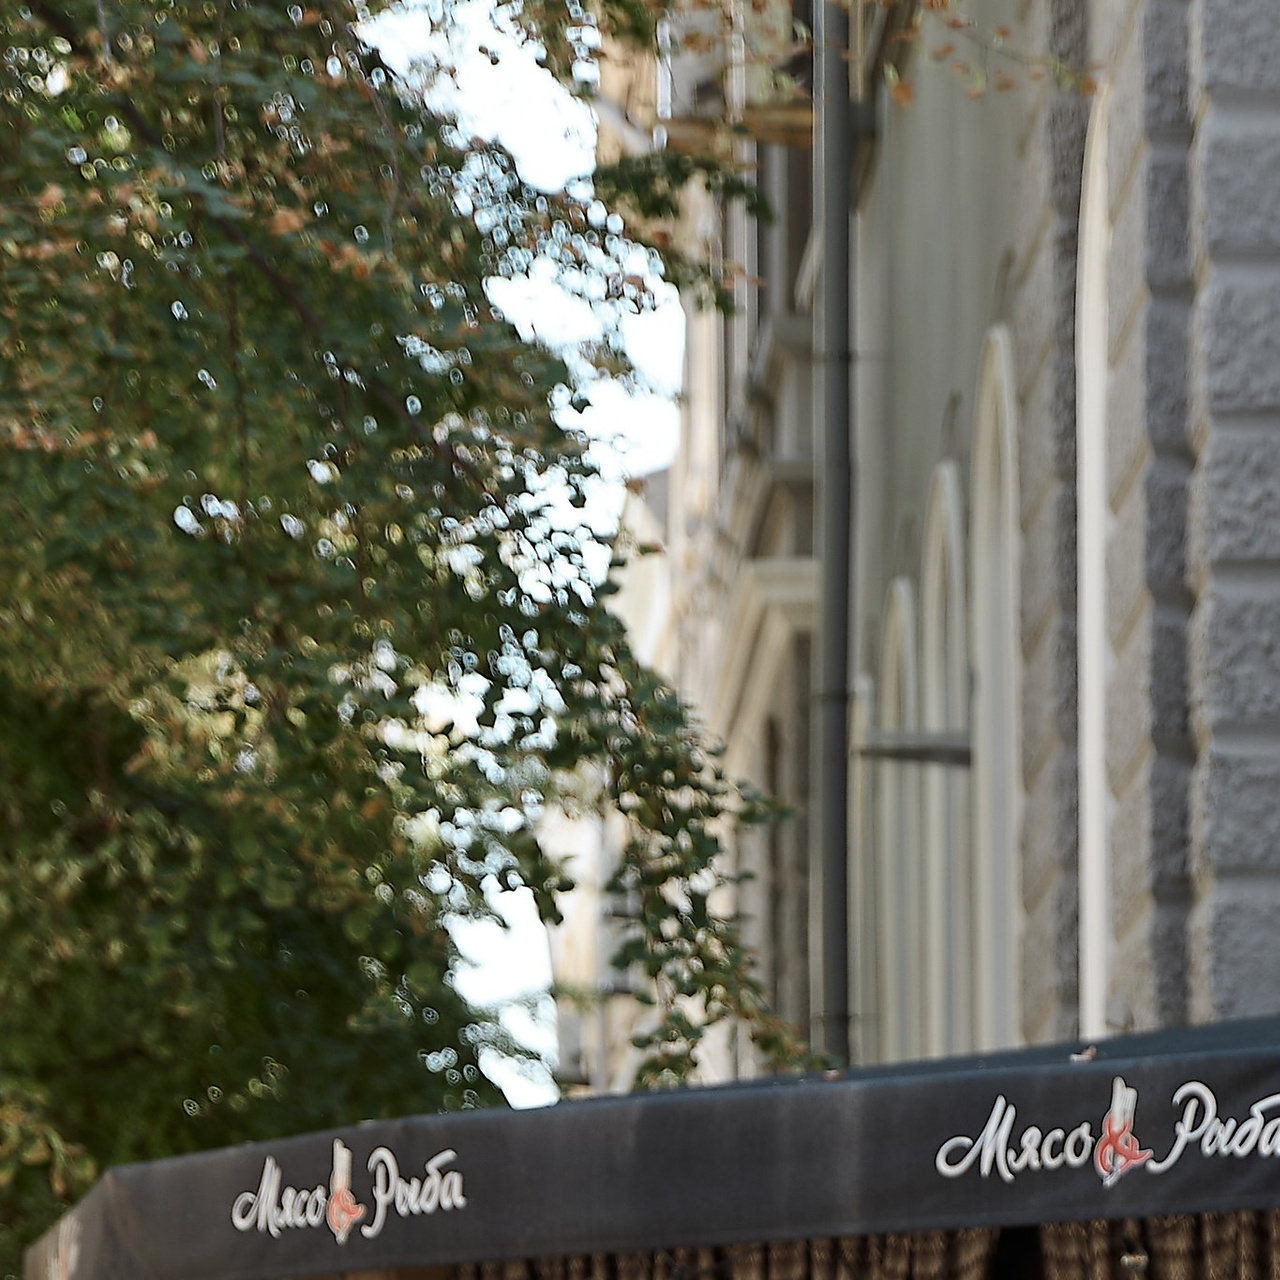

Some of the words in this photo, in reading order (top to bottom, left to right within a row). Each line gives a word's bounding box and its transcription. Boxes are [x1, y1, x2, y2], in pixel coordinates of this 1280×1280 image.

[935, 1095, 1096, 1183] Мясо
[232, 1155, 327, 1239] Мясо
[361, 1146, 467, 1239] Рыба
